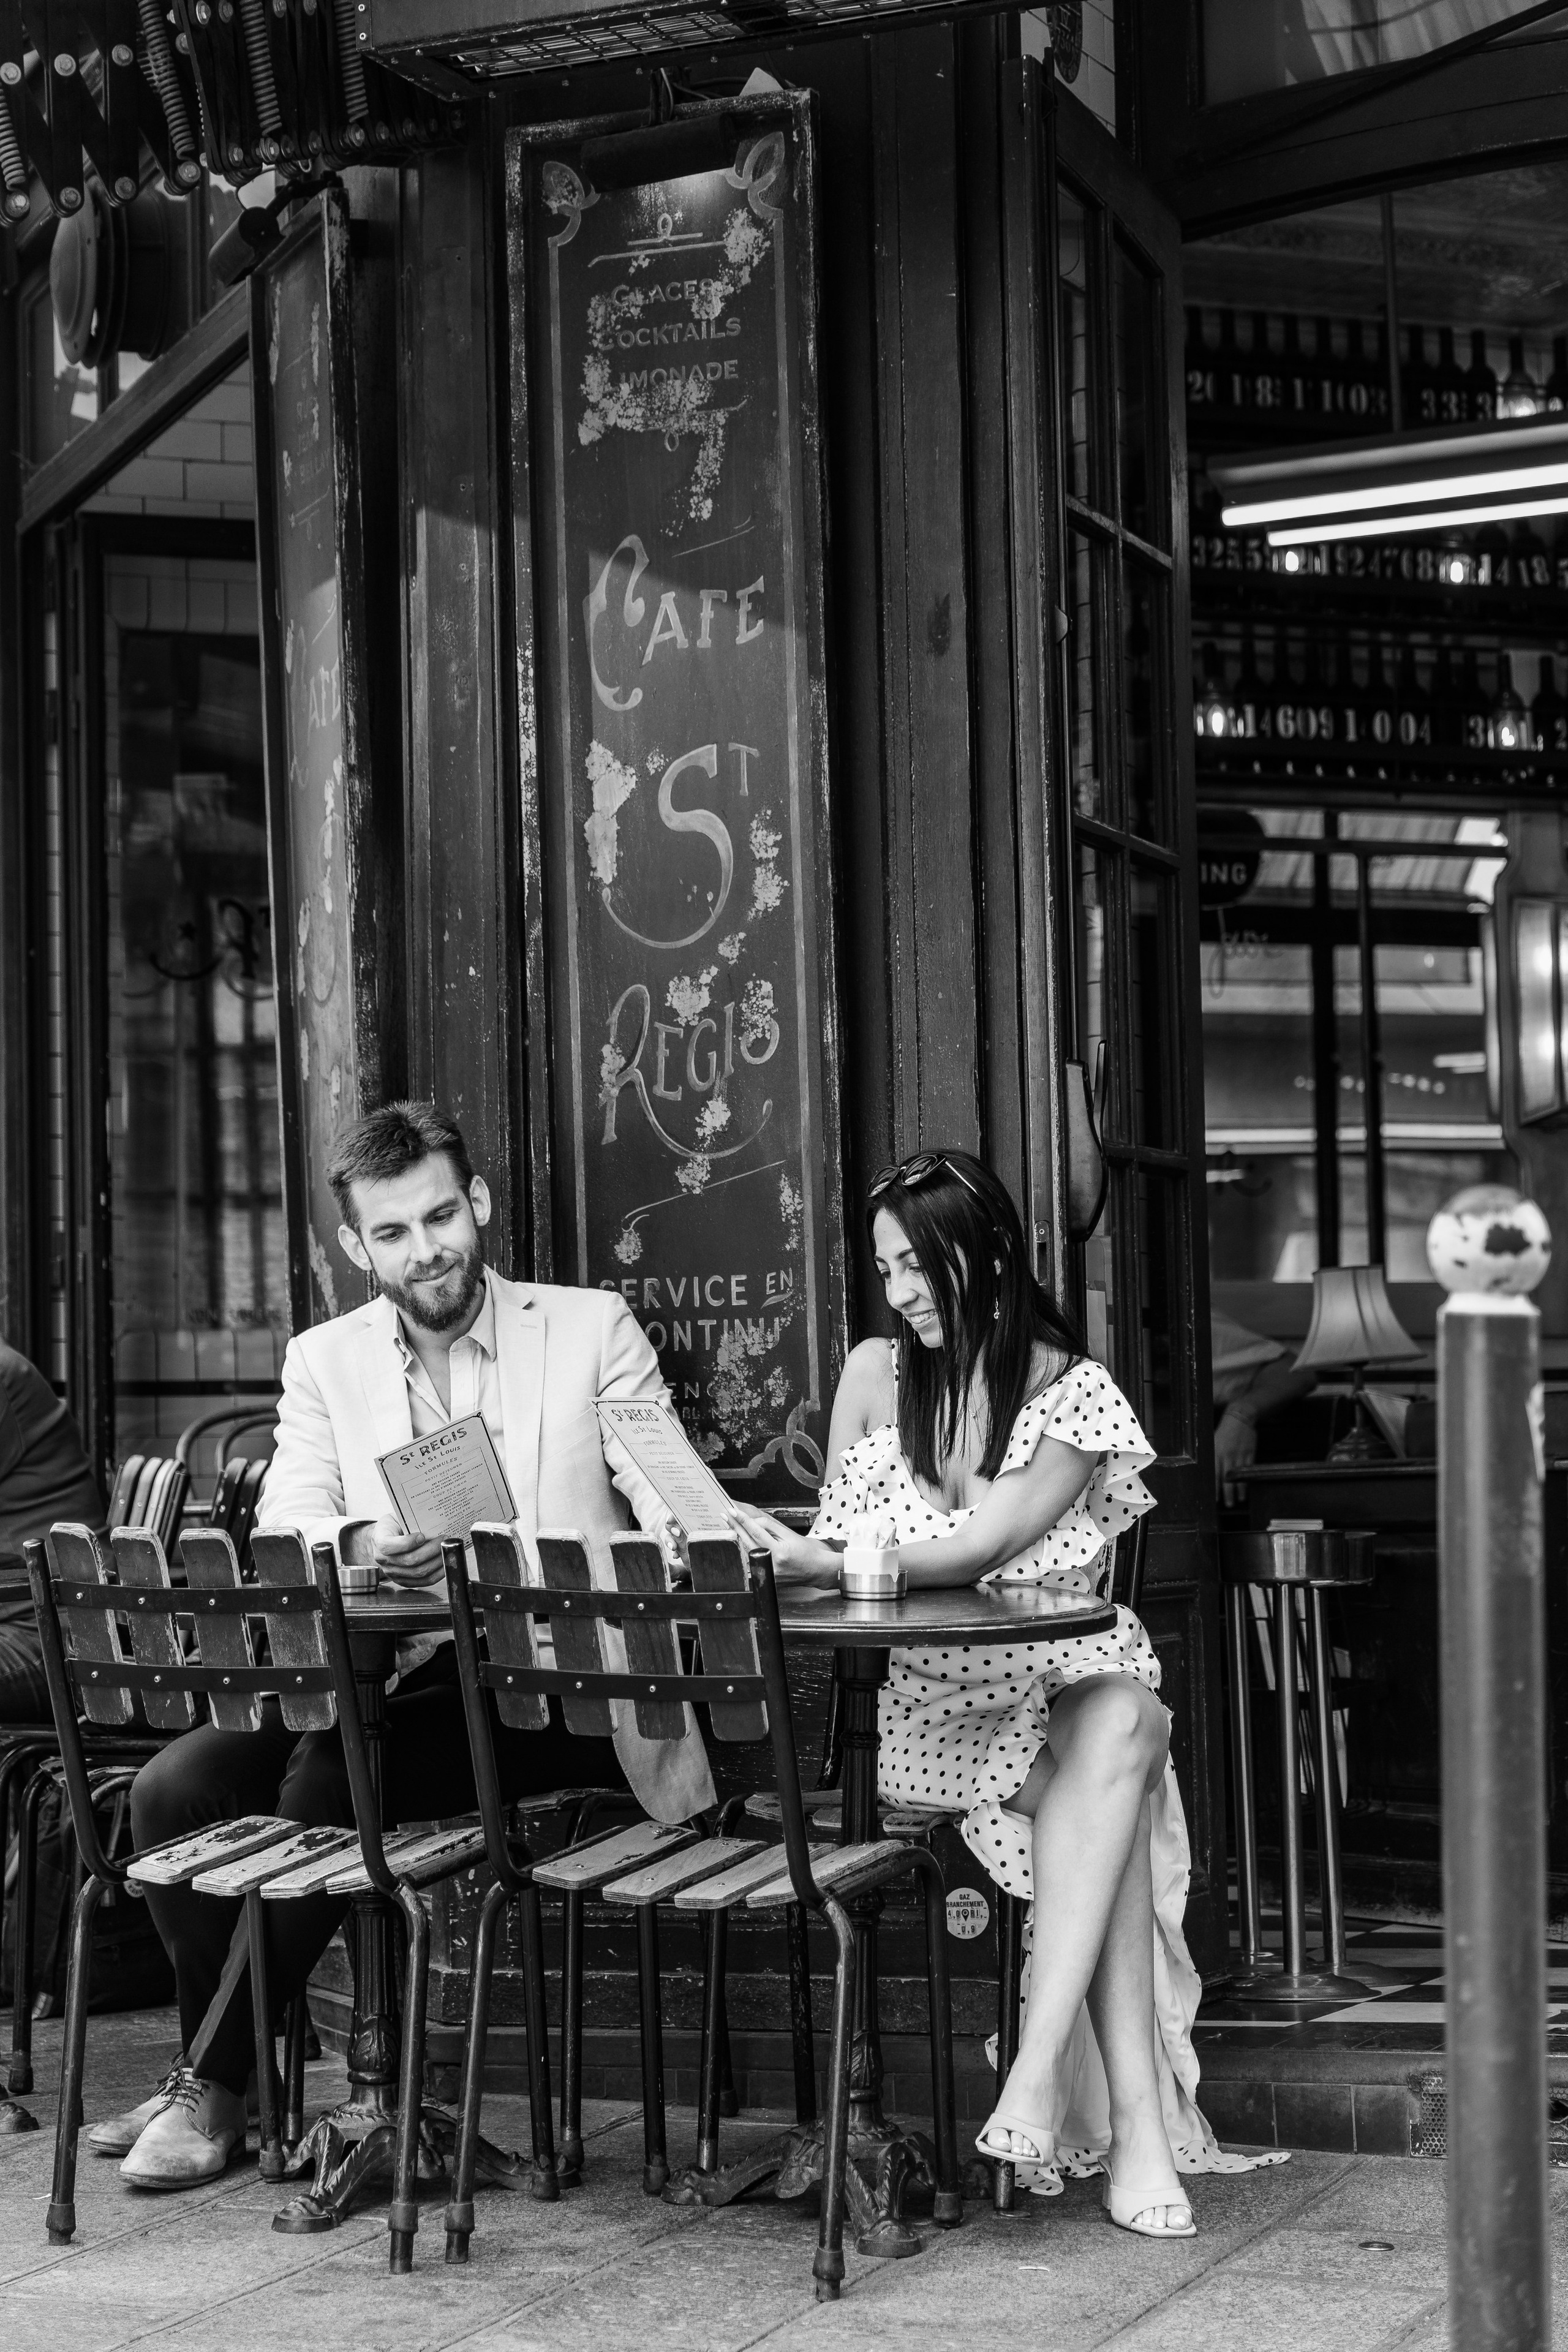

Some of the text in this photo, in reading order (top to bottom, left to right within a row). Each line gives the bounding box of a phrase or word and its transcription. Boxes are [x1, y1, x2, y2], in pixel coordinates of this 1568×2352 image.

[606, 360, 739, 391] IMONADE
[766, 1267, 794, 1295] EN
[641, 1317, 780, 1352] ONTINU
[623, 1408, 660, 1422] REGIS
[419, 1427, 467, 1457] REGIS
[440, 1446, 461, 1457] LOUIS
[424, 1457, 458, 1476] FORMULES
